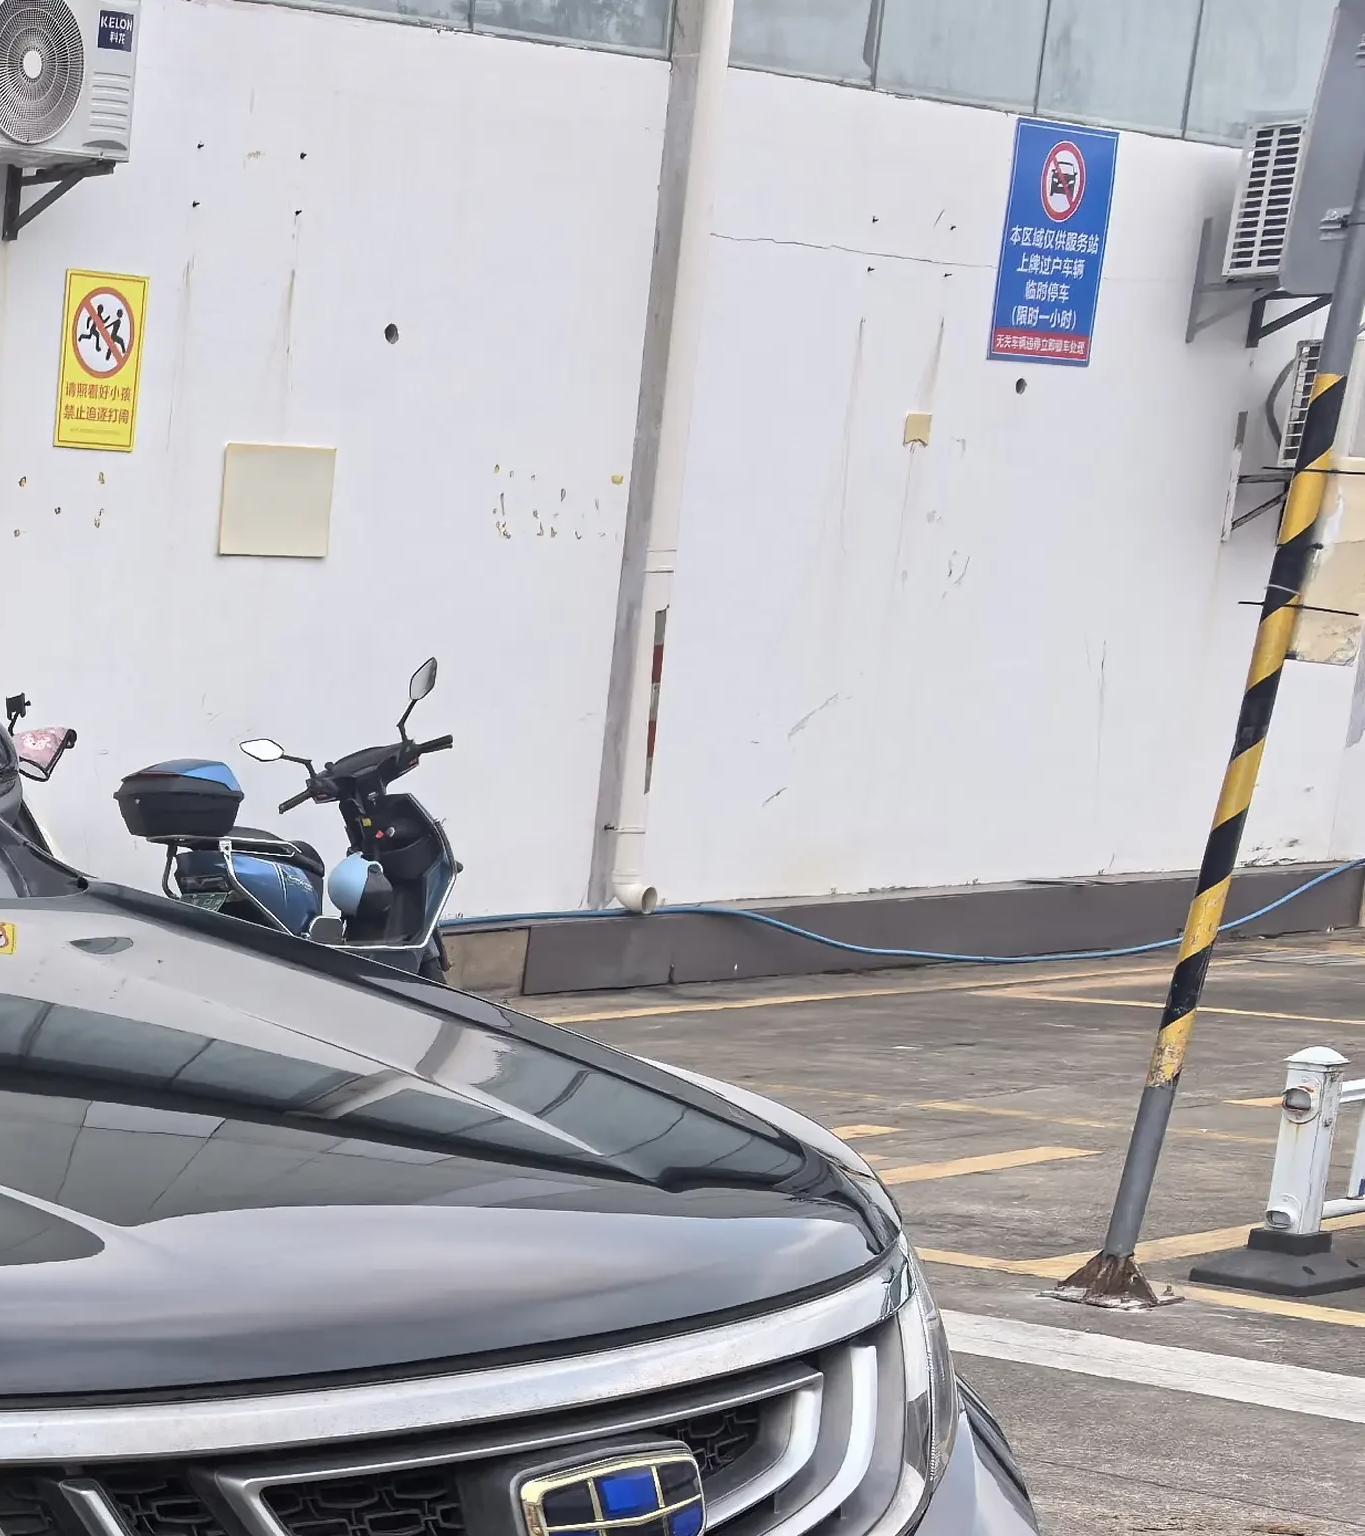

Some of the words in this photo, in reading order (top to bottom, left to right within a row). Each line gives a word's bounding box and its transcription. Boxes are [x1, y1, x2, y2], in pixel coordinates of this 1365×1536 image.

[1010, 225, 1099, 255] 本区域仅供服务站
[1016, 252, 1085, 279] 上牌过户车辆
[1025, 279, 1071, 304] 临时停车
[65, 381, 131, 403] 请照看好小孩
[63, 403, 130, 425] 禁止追逐打闹
